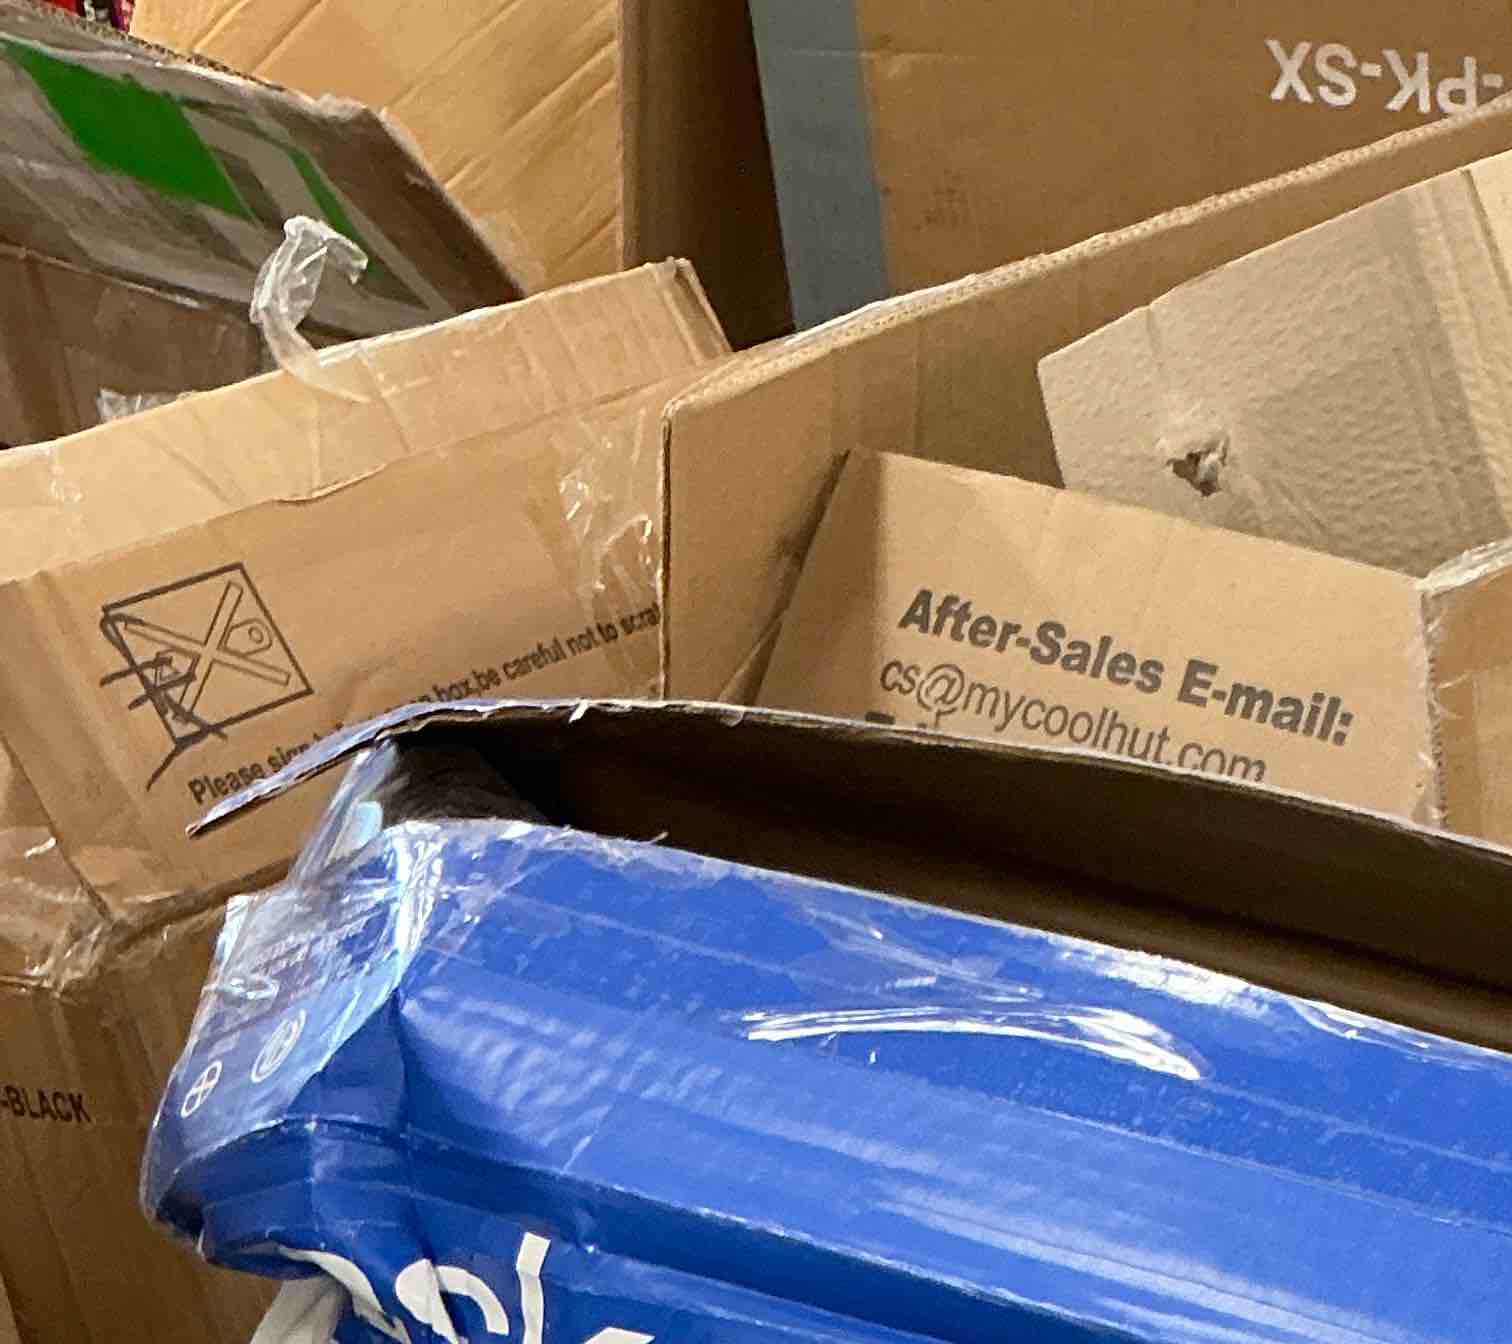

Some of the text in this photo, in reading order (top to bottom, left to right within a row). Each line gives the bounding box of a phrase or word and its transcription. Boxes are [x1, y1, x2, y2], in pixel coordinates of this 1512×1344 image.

[187, 761, 266, 804] Please
[502, 637, 568, 681] careful
[566, 625, 602, 657] not
[596, 621, 619, 644] to
[879, 658, 1267, 783] cs@mycoolhut.com
[897, 587, 1354, 747] After-Sales E-mail:
